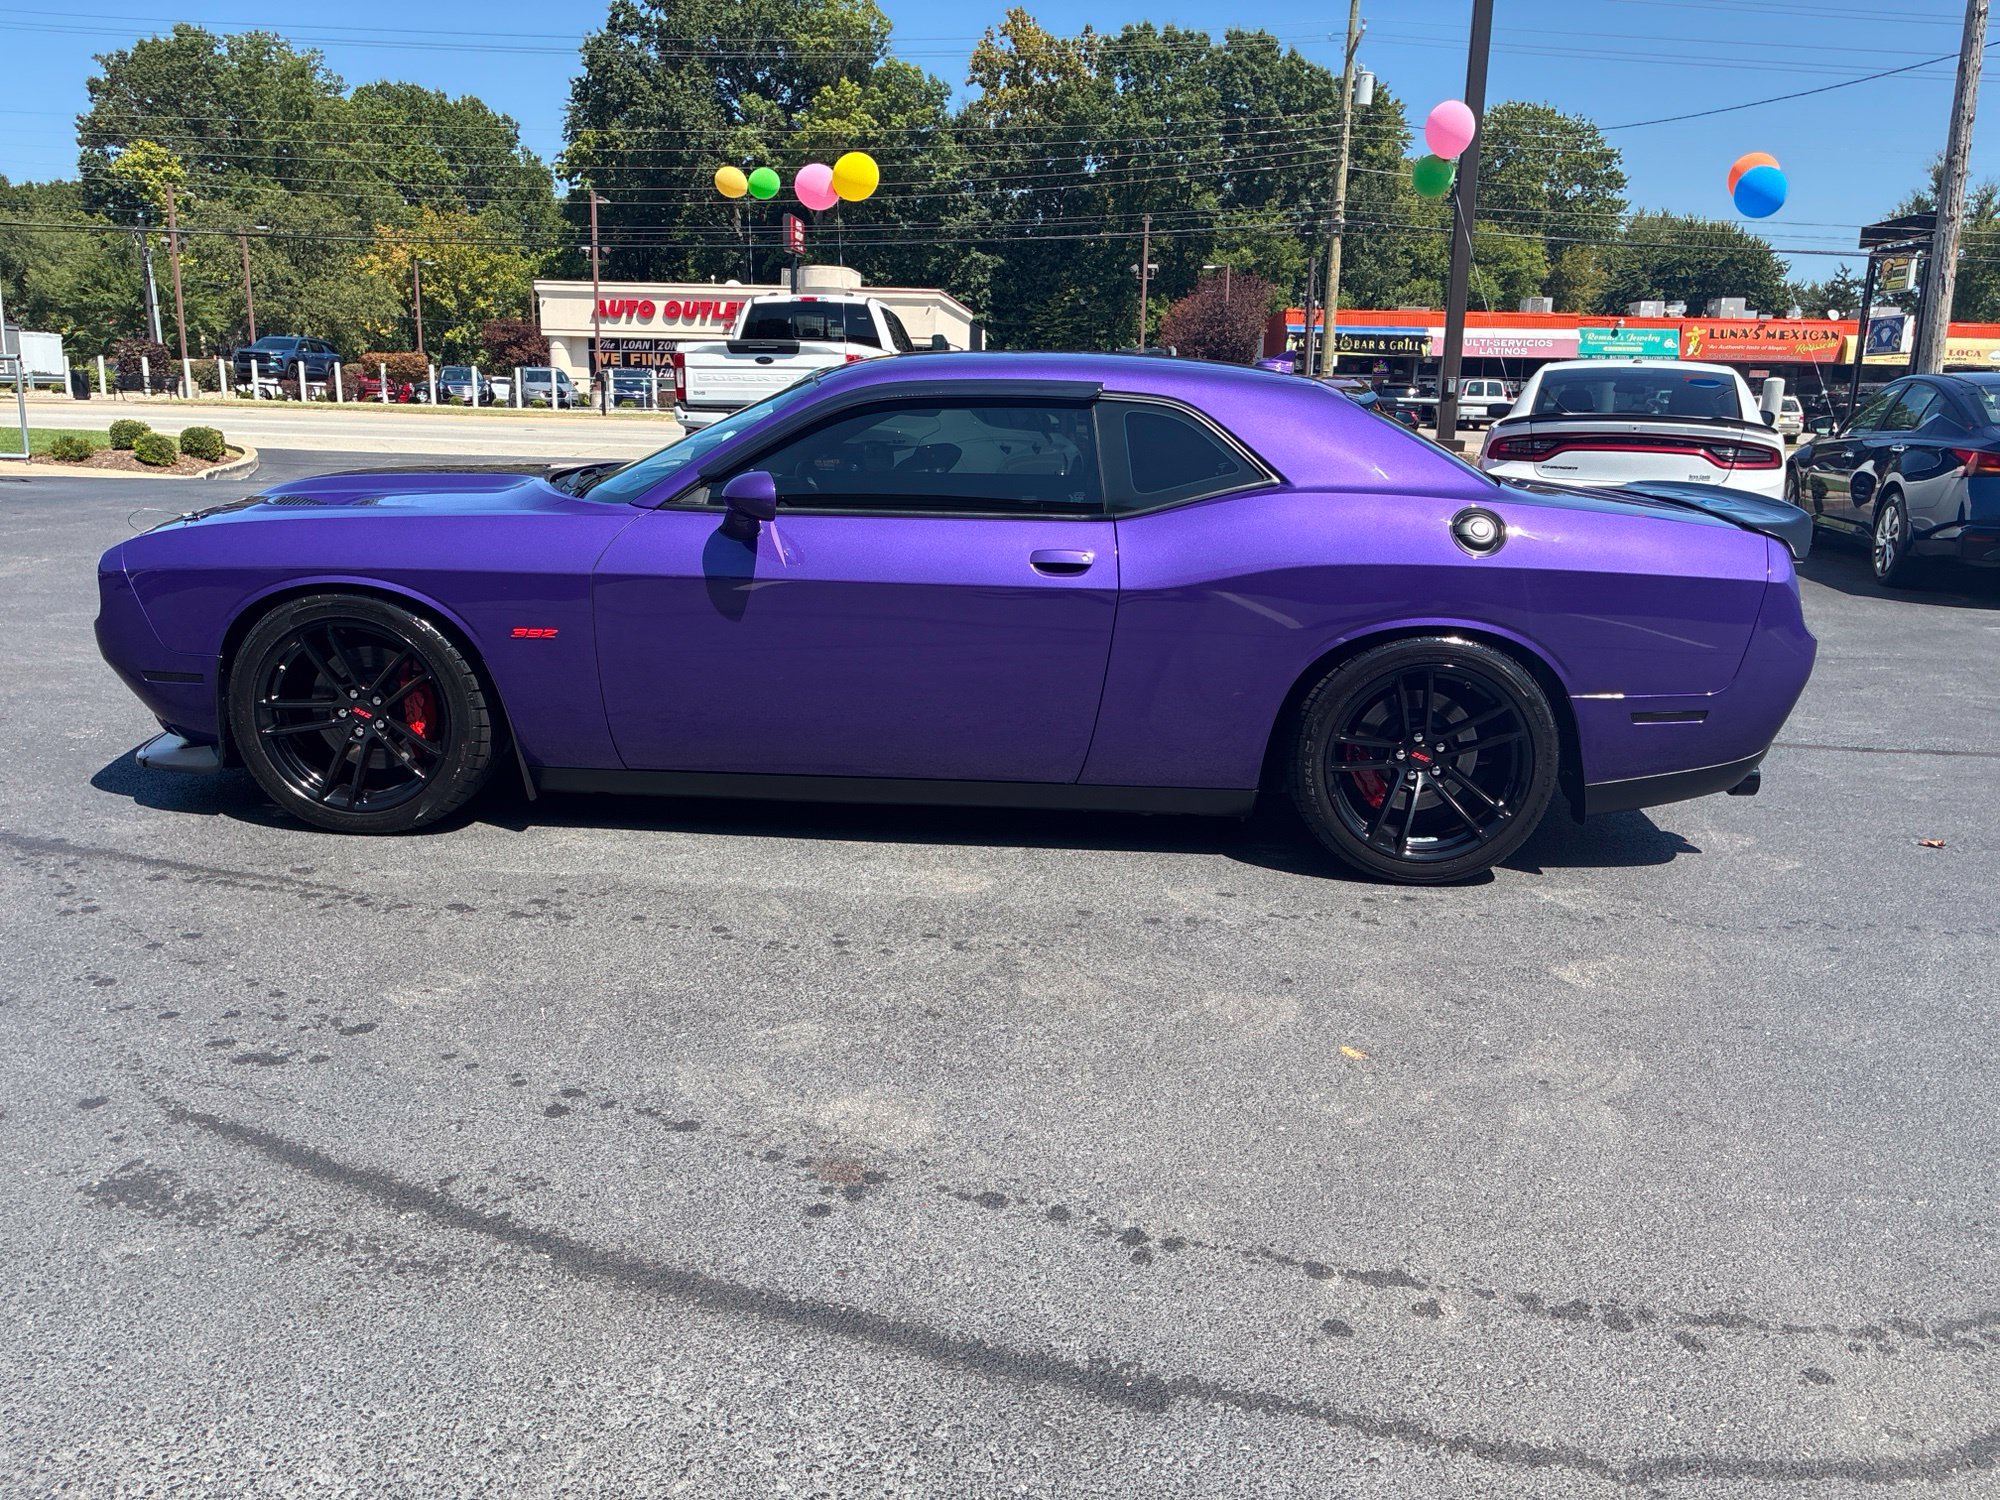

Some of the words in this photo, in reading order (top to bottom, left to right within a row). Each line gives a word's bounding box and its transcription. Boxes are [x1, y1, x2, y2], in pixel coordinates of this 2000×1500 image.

[594, 300, 656, 319] AUTO
[1709, 328, 1761, 340] LUNA'S
[1766, 328, 1839, 341] MEXICAN
[622, 340, 651, 350] LOAN
[657, 341, 678, 350] ZON
[1354, 340, 1375, 349] BAR
[1378, 340, 1386, 350] &
[1389, 337, 1420, 351] GRILL
[1464, 339, 1553, 347] ULTI-SERVICIOS
[594, 353, 622, 366] WE
[629, 353, 675, 366] FINA
[1948, 349, 1982, 358] LOCA
[511, 628, 558, 638] 392
[352, 706, 373, 719] 392
